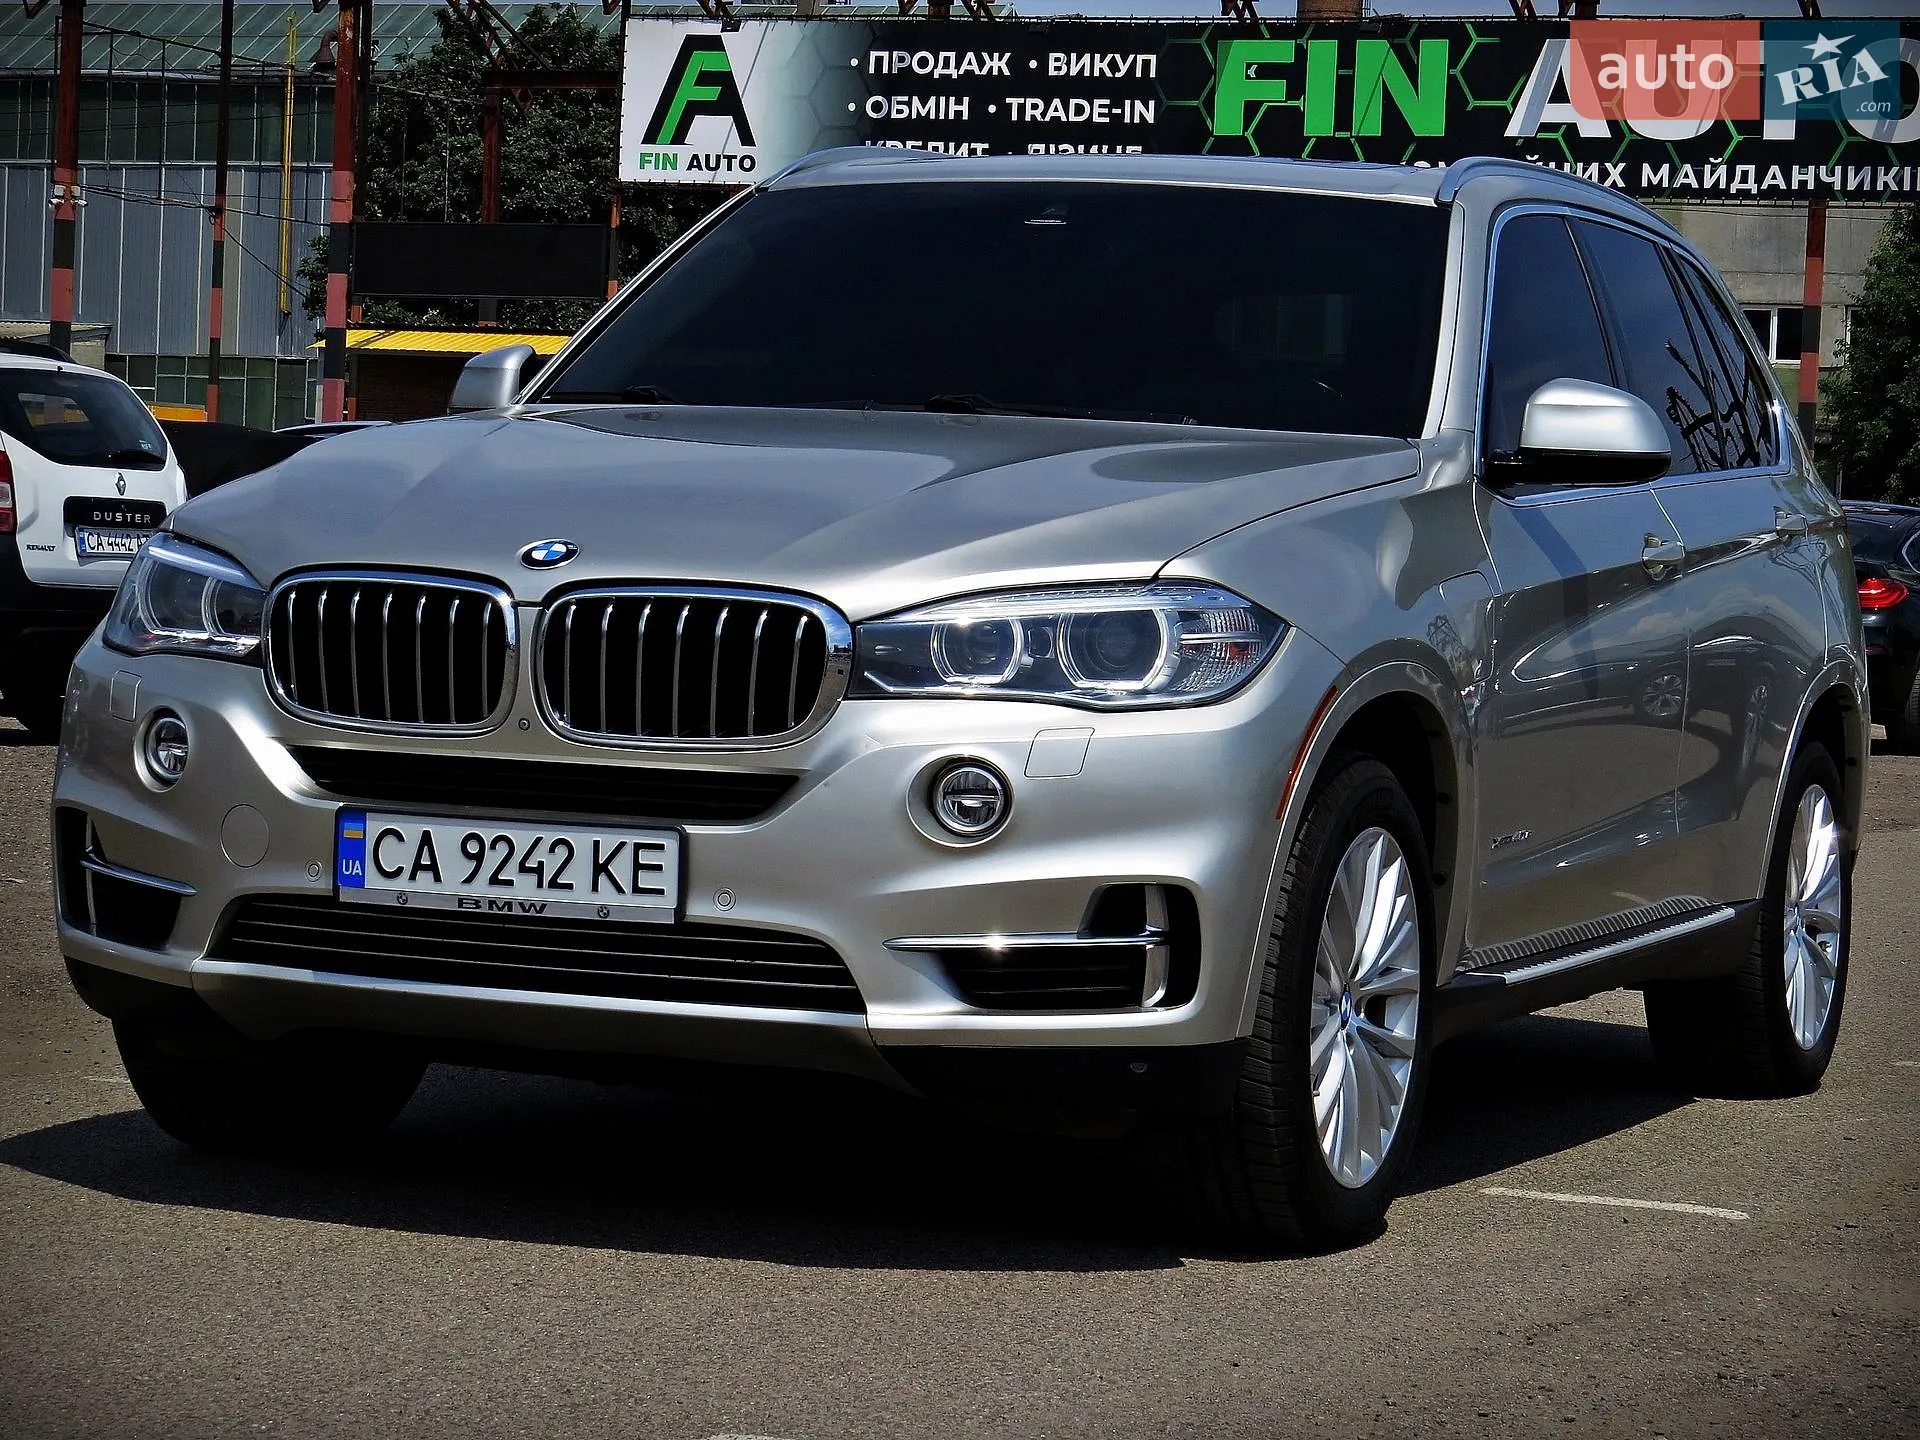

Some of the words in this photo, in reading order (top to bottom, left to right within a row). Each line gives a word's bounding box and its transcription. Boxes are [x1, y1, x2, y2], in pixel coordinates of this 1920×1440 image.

[867, 50, 1012, 79] ПРОДАЖ
[1048, 53, 1158, 78] ВИКУП
[1213, 38, 1449, 137] FIN
[865, 95, 969, 120] ОБМІН
[1006, 97, 1156, 125] TRADE-IN
[640, 153, 678, 172] FIN
[686, 153, 756, 174] AUTO
[1641, 157, 1920, 194] МАЙДАНЧИКІ
[93, 511, 152, 524] DUSTER
[87, 532, 105, 551] CA
[107, 532, 134, 552] 4442
[342, 859, 363, 877] UA
[372, 826, 444, 883] CA
[460, 831, 576, 891] 9242
[591, 838, 667, 896] KE
[457, 897, 548, 915] BMW
